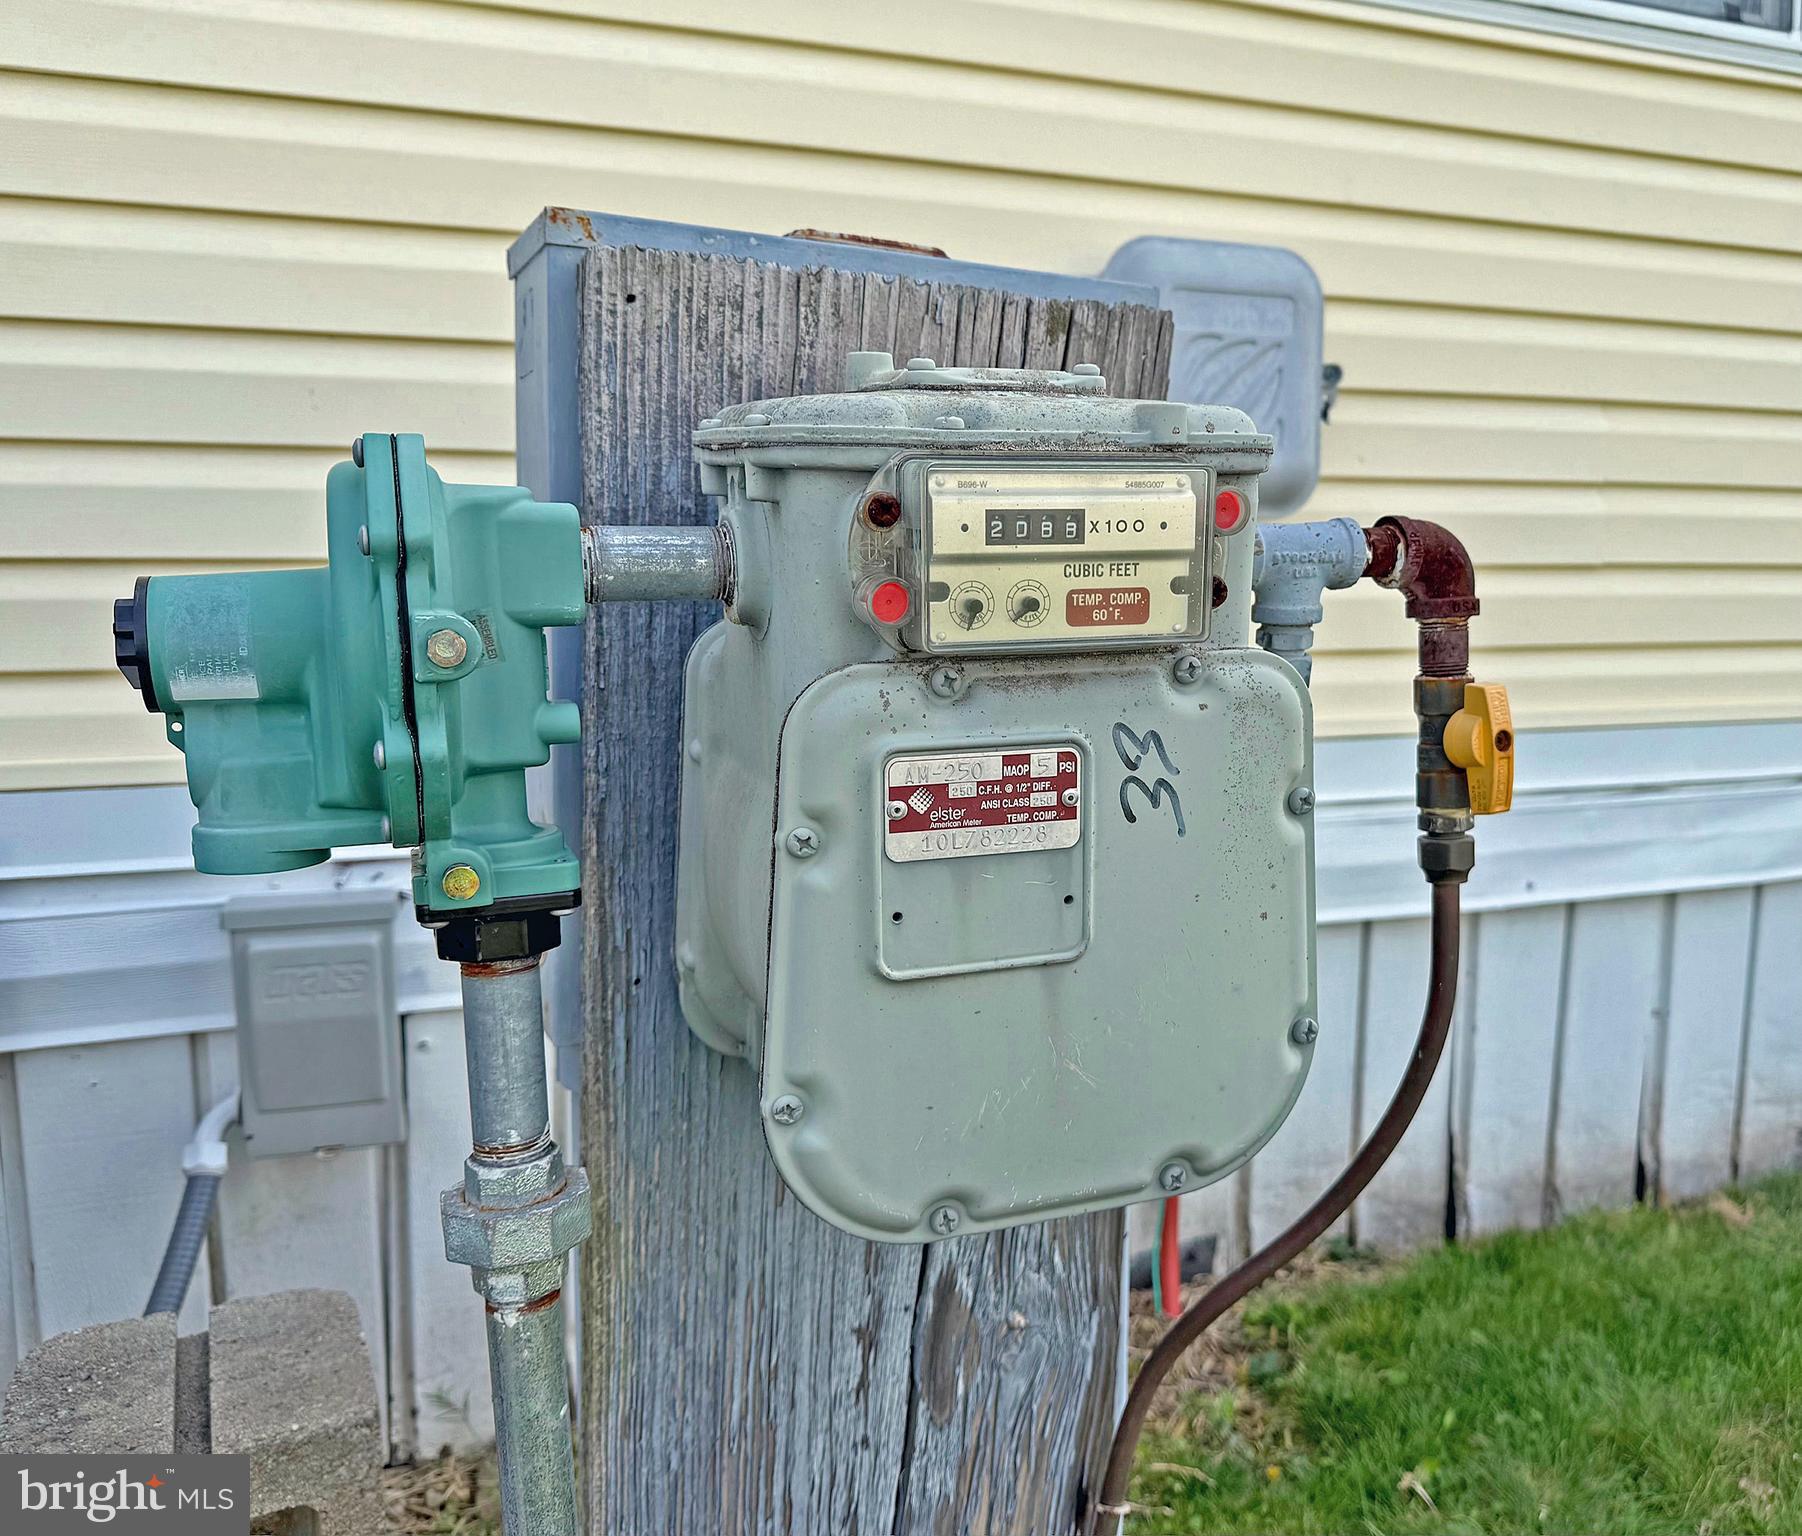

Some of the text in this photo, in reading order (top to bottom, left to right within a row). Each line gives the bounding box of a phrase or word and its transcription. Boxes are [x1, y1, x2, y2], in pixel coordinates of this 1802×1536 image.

[1063, 562, 1140, 578] CUBIC FEET
[1071, 592, 1145, 607] TEMP. COMP.
[478, 614, 498, 660] ASSEMBLED
[904, 761, 983, 785] AM-250
[1003, 757, 1075, 777] MAOP 5 PSI
[952, 785, 973, 797] 250
[978, 784, 1003, 795] C.F.H.
[1032, 781, 1053, 791] DIFF.
[980, 795, 1053, 810] ANSI CLASS 250
[930, 806, 967, 822] elster
[1006, 810, 1059, 823] TEMP. COMP.
[929, 818, 983, 829] American Meter
[921, 825, 1048, 853] 10L782228
